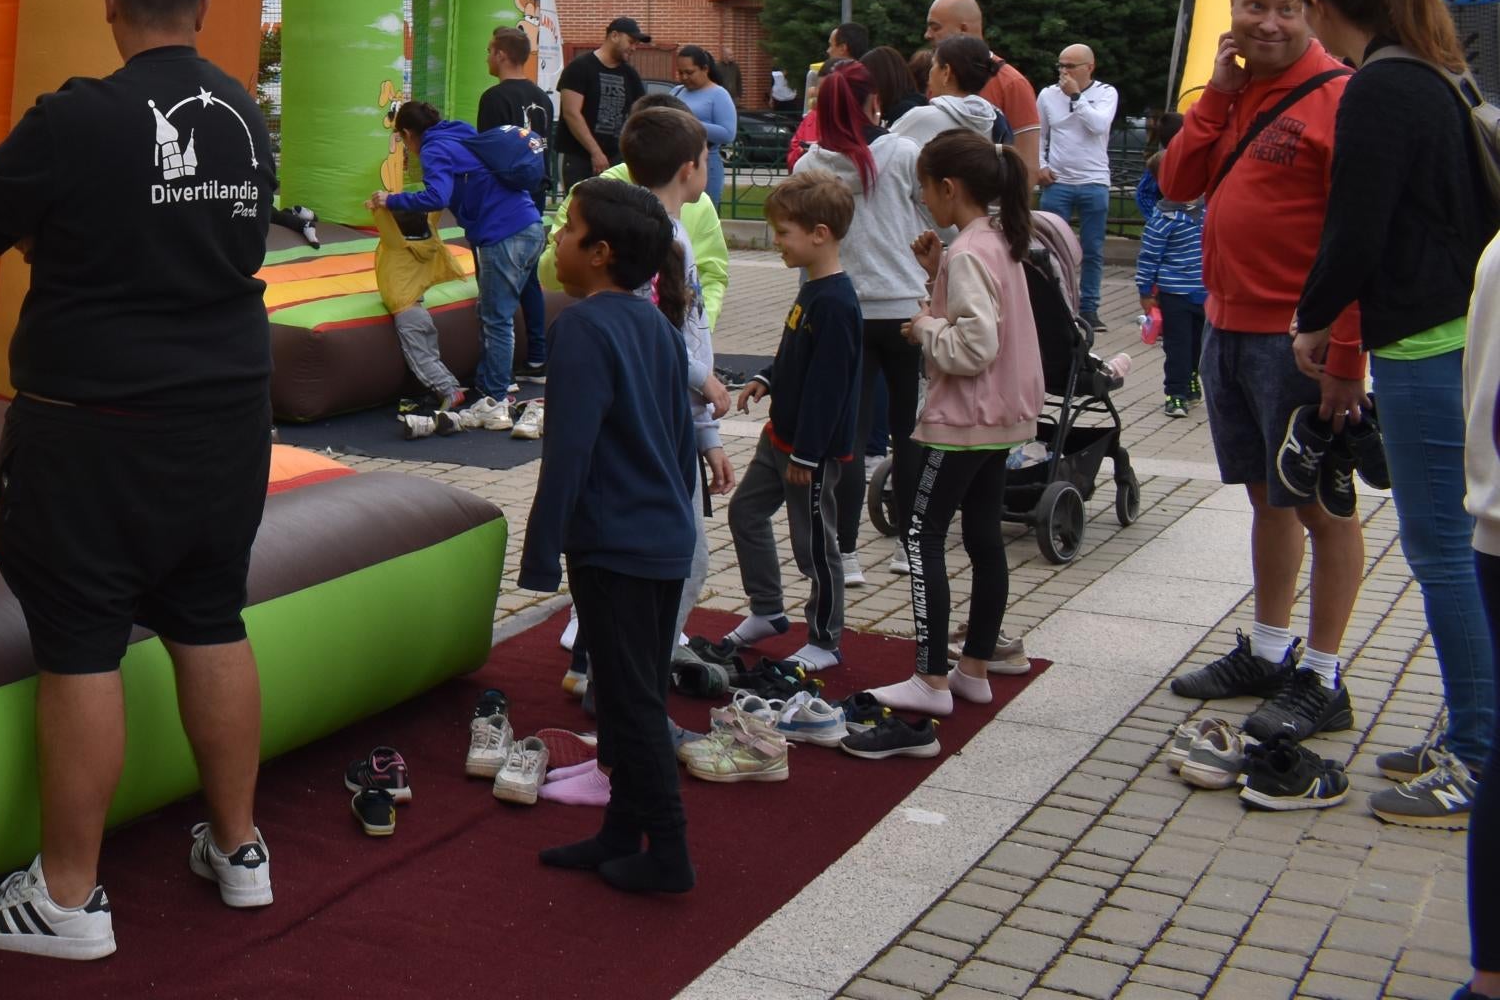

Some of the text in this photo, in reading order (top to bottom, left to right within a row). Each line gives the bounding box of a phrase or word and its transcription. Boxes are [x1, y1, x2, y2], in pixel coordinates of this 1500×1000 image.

[151, 180, 258, 204] Divertilandia
[231, 201, 258, 218] Park
[912, 576, 927, 619] MICKEY
